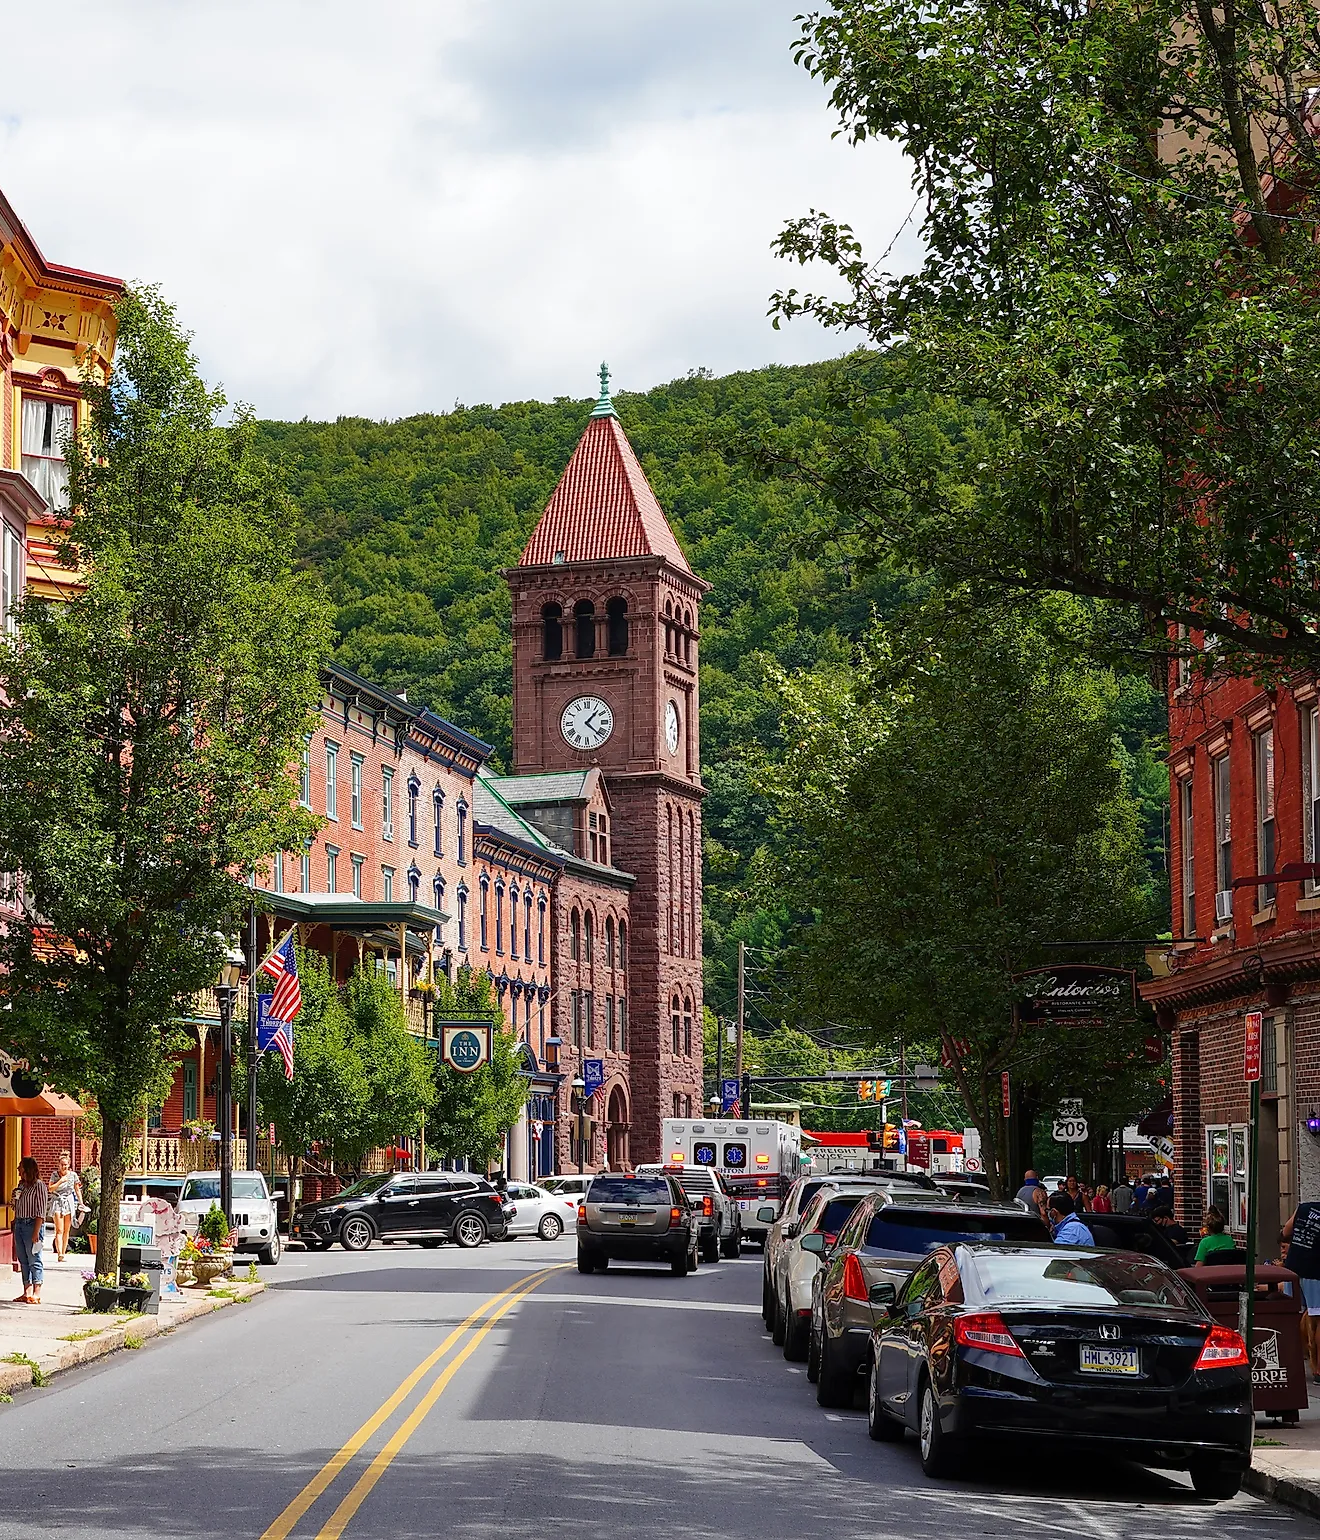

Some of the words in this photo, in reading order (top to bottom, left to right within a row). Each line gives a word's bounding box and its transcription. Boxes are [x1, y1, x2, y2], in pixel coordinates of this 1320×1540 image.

[452, 1046, 479, 1057] INN
[1056, 1122, 1085, 1137] 209
[138, 1231, 150, 1244] END
